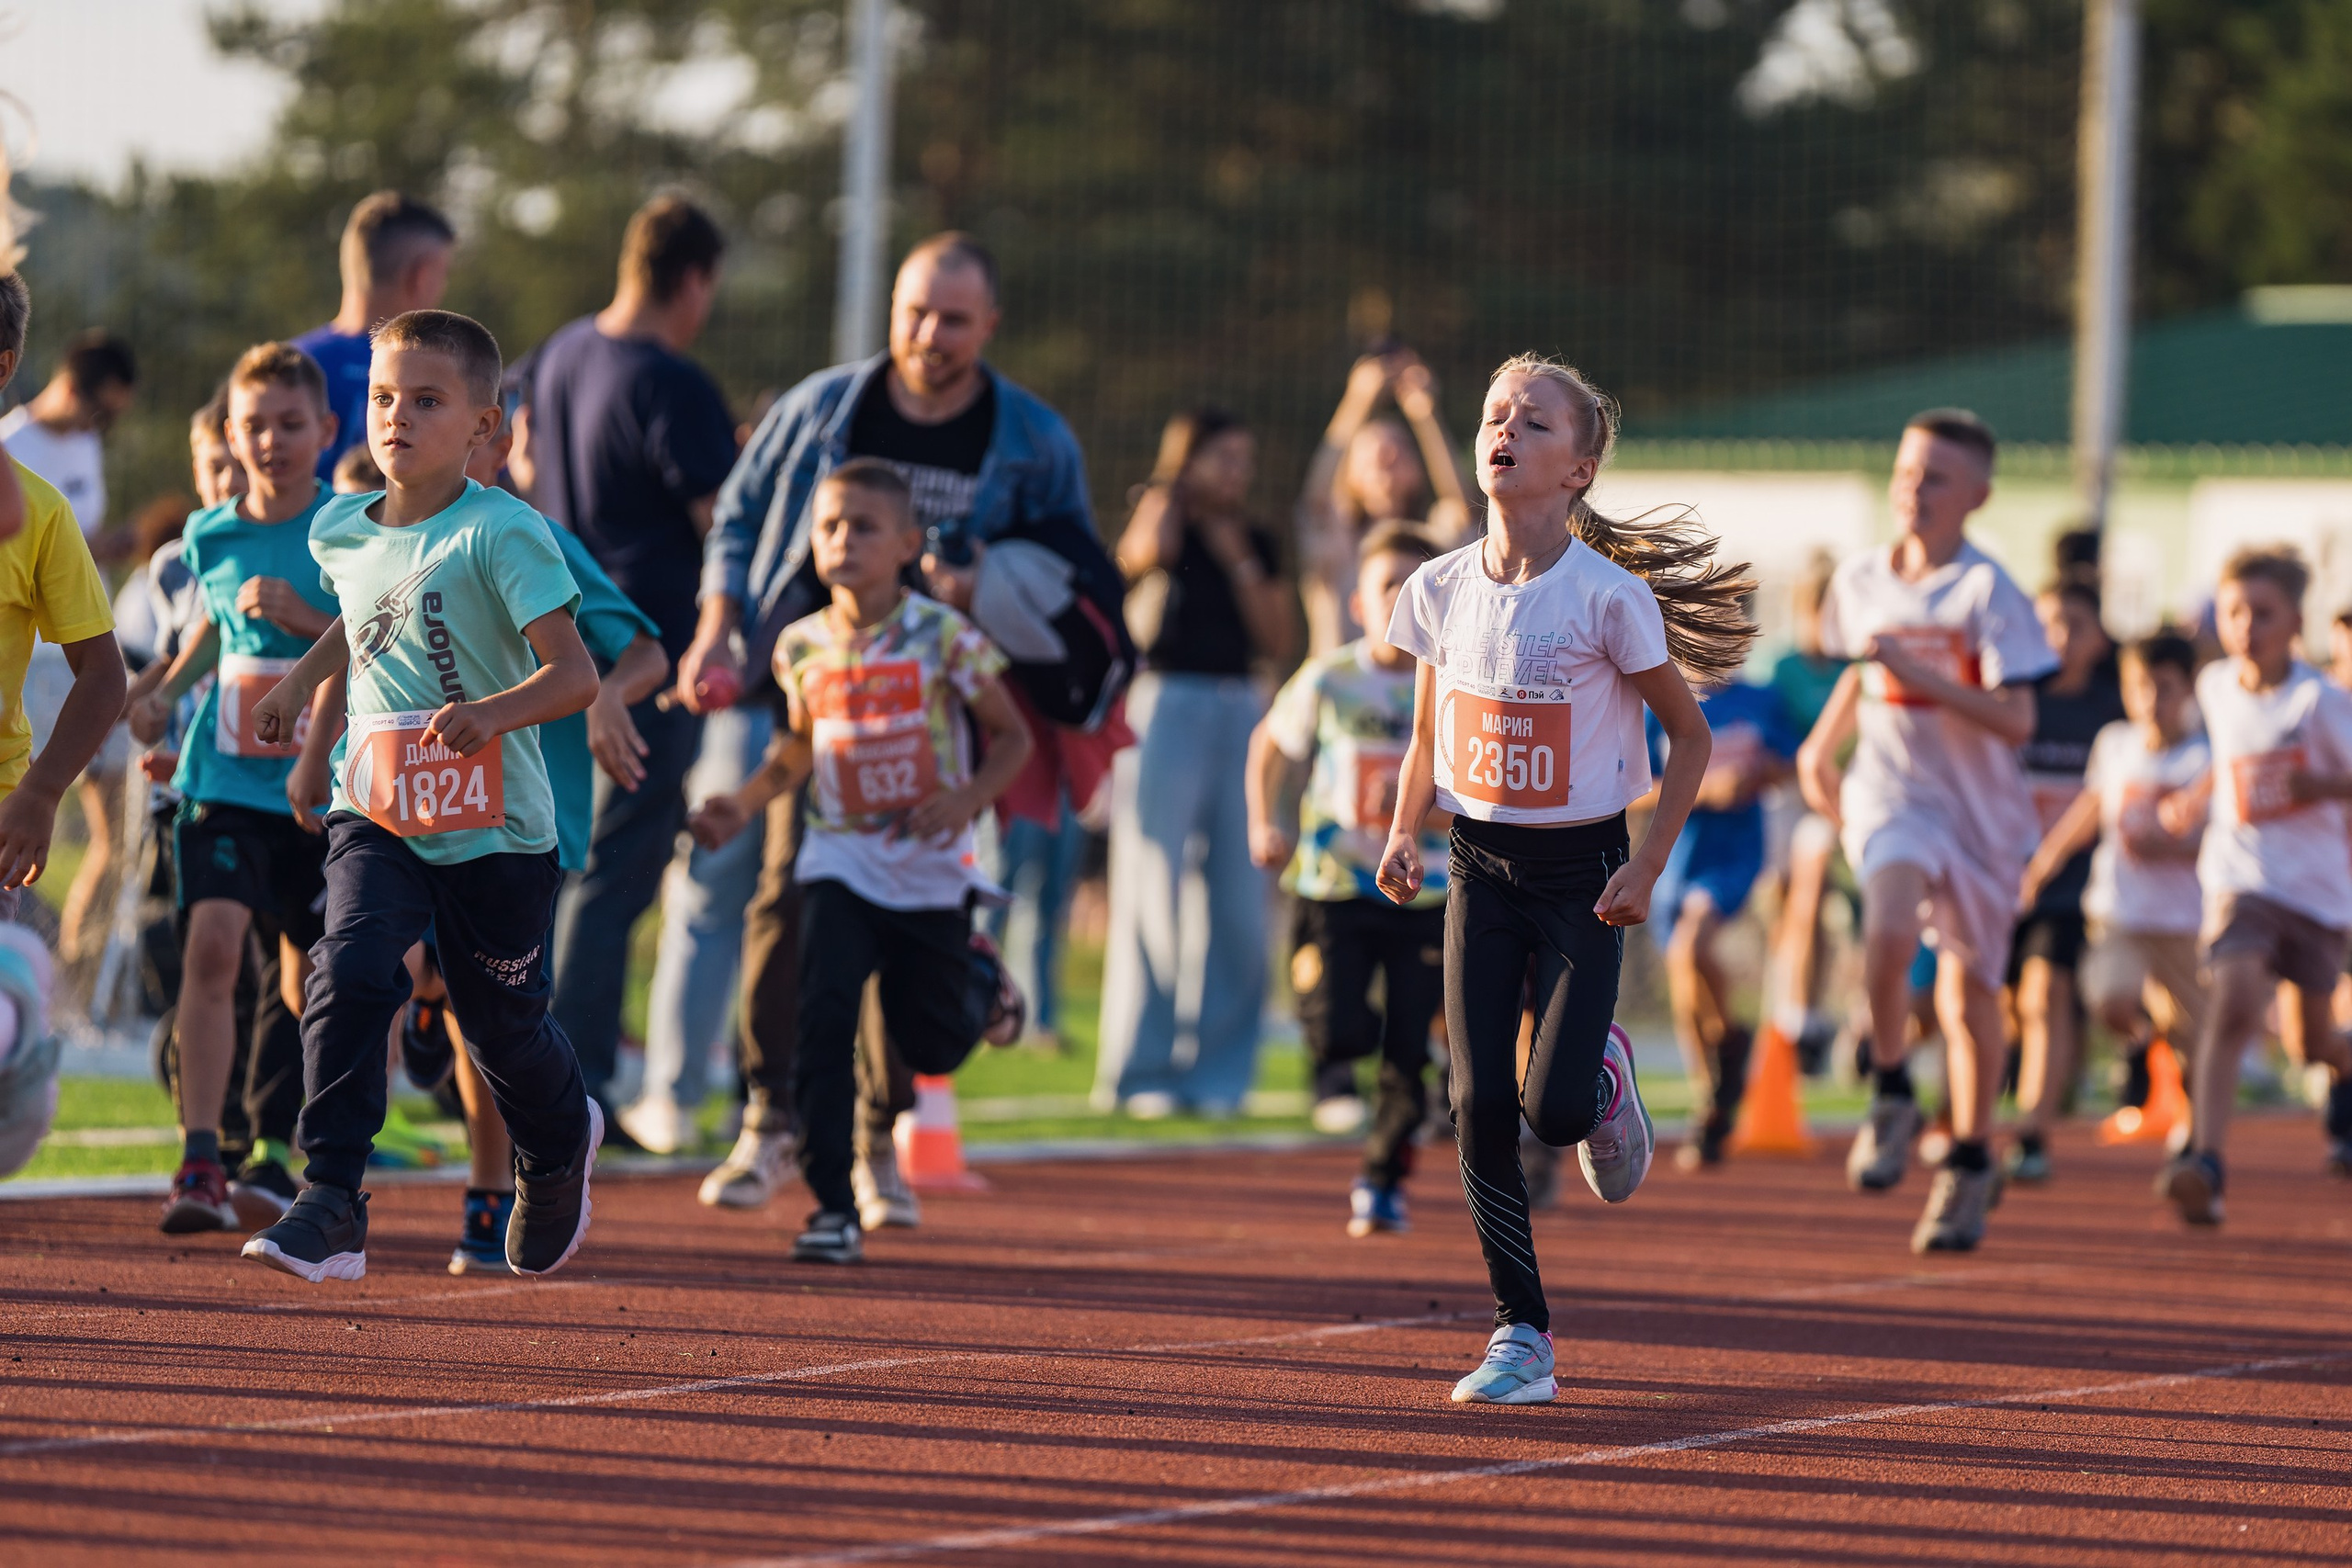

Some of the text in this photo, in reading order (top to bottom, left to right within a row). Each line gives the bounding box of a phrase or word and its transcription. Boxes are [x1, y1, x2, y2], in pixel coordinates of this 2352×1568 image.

[1496, 630, 1573, 659] STEP
[1528, 691, 1544, 699] Пэй
[1482, 712, 1532, 738] МАРИЯ
[404, 742, 459, 767] ДАМИ
[1467, 736, 1554, 792] 2350
[392, 765, 489, 821] 1824
